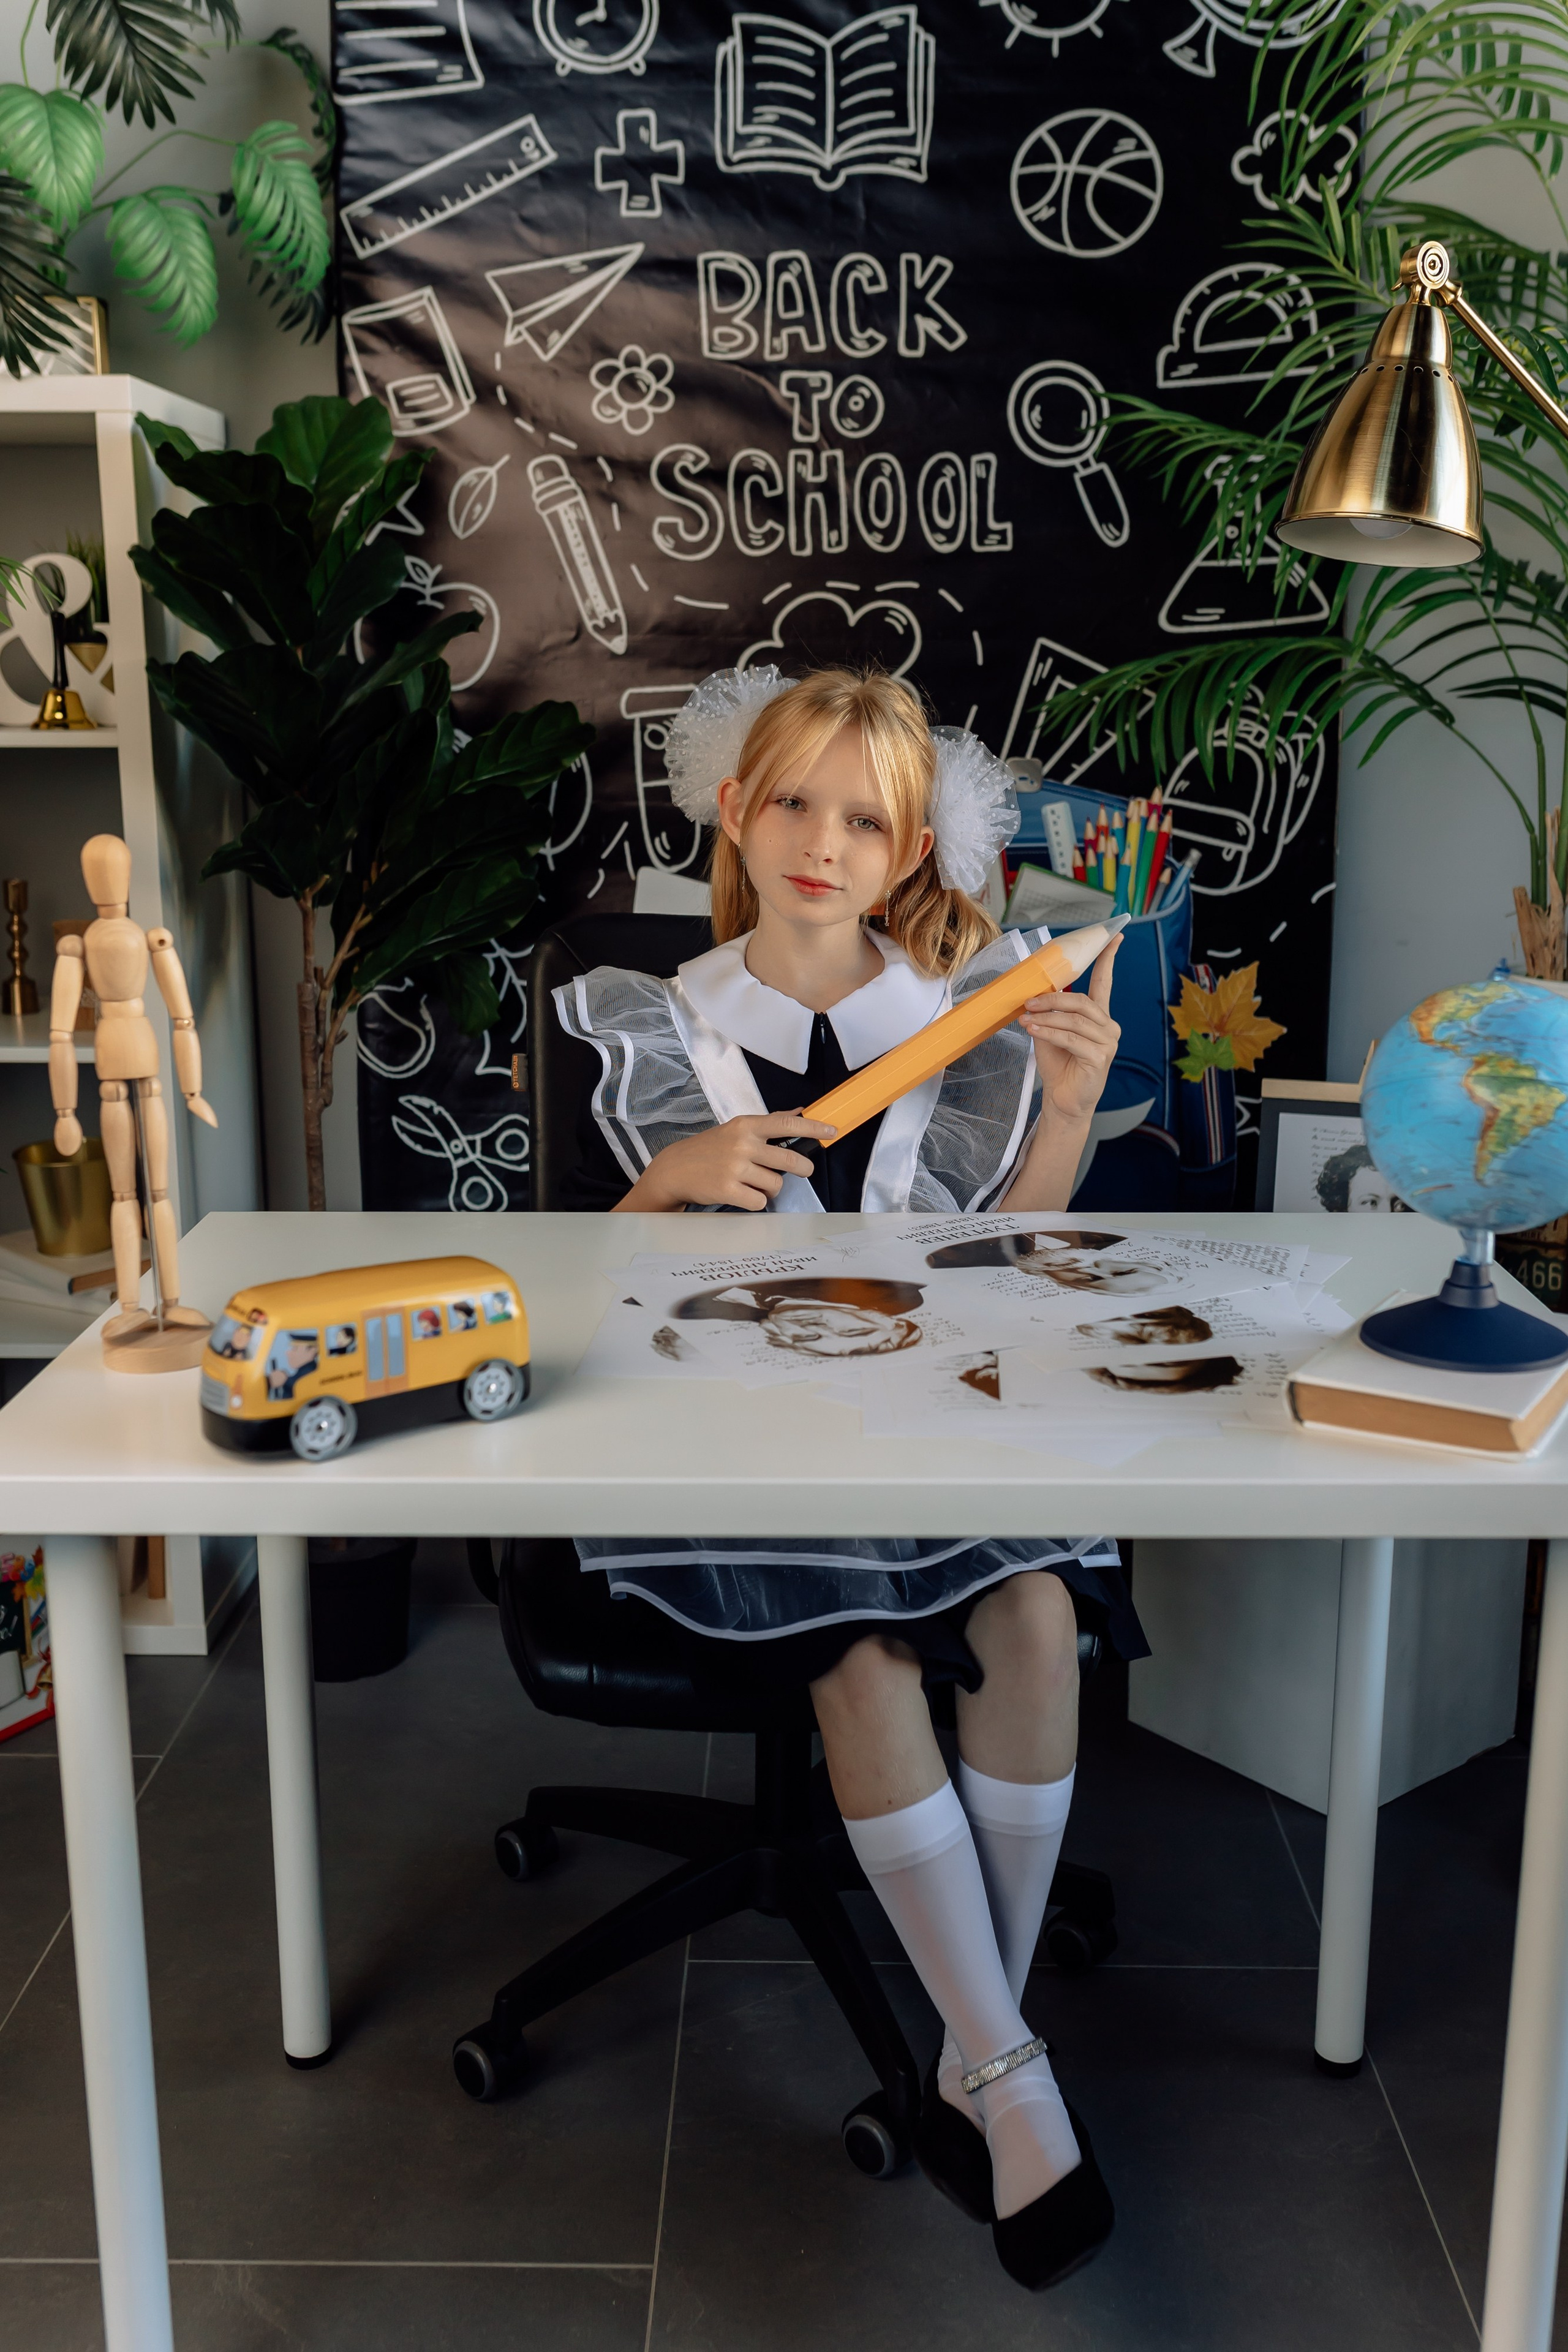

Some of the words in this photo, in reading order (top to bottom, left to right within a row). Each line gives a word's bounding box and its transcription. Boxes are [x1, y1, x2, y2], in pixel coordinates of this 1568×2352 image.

[697, 249, 967, 361] BACK
[780, 371, 884, 442] TO
[650, 443, 1013, 562] SCHOOL
[976, 1216, 1016, 1226] ИВАН
[895, 1223, 975, 1241] СЕРГЕЕВИЧ
[914, 1224, 1020, 1245] ТУРГЕНЕВ
[669, 1261, 767, 1278] АНДРЕЕВИЧ
[771, 1256, 818, 1266] ИВАН
[698, 1264, 805, 1282] КРЫЛОВ
